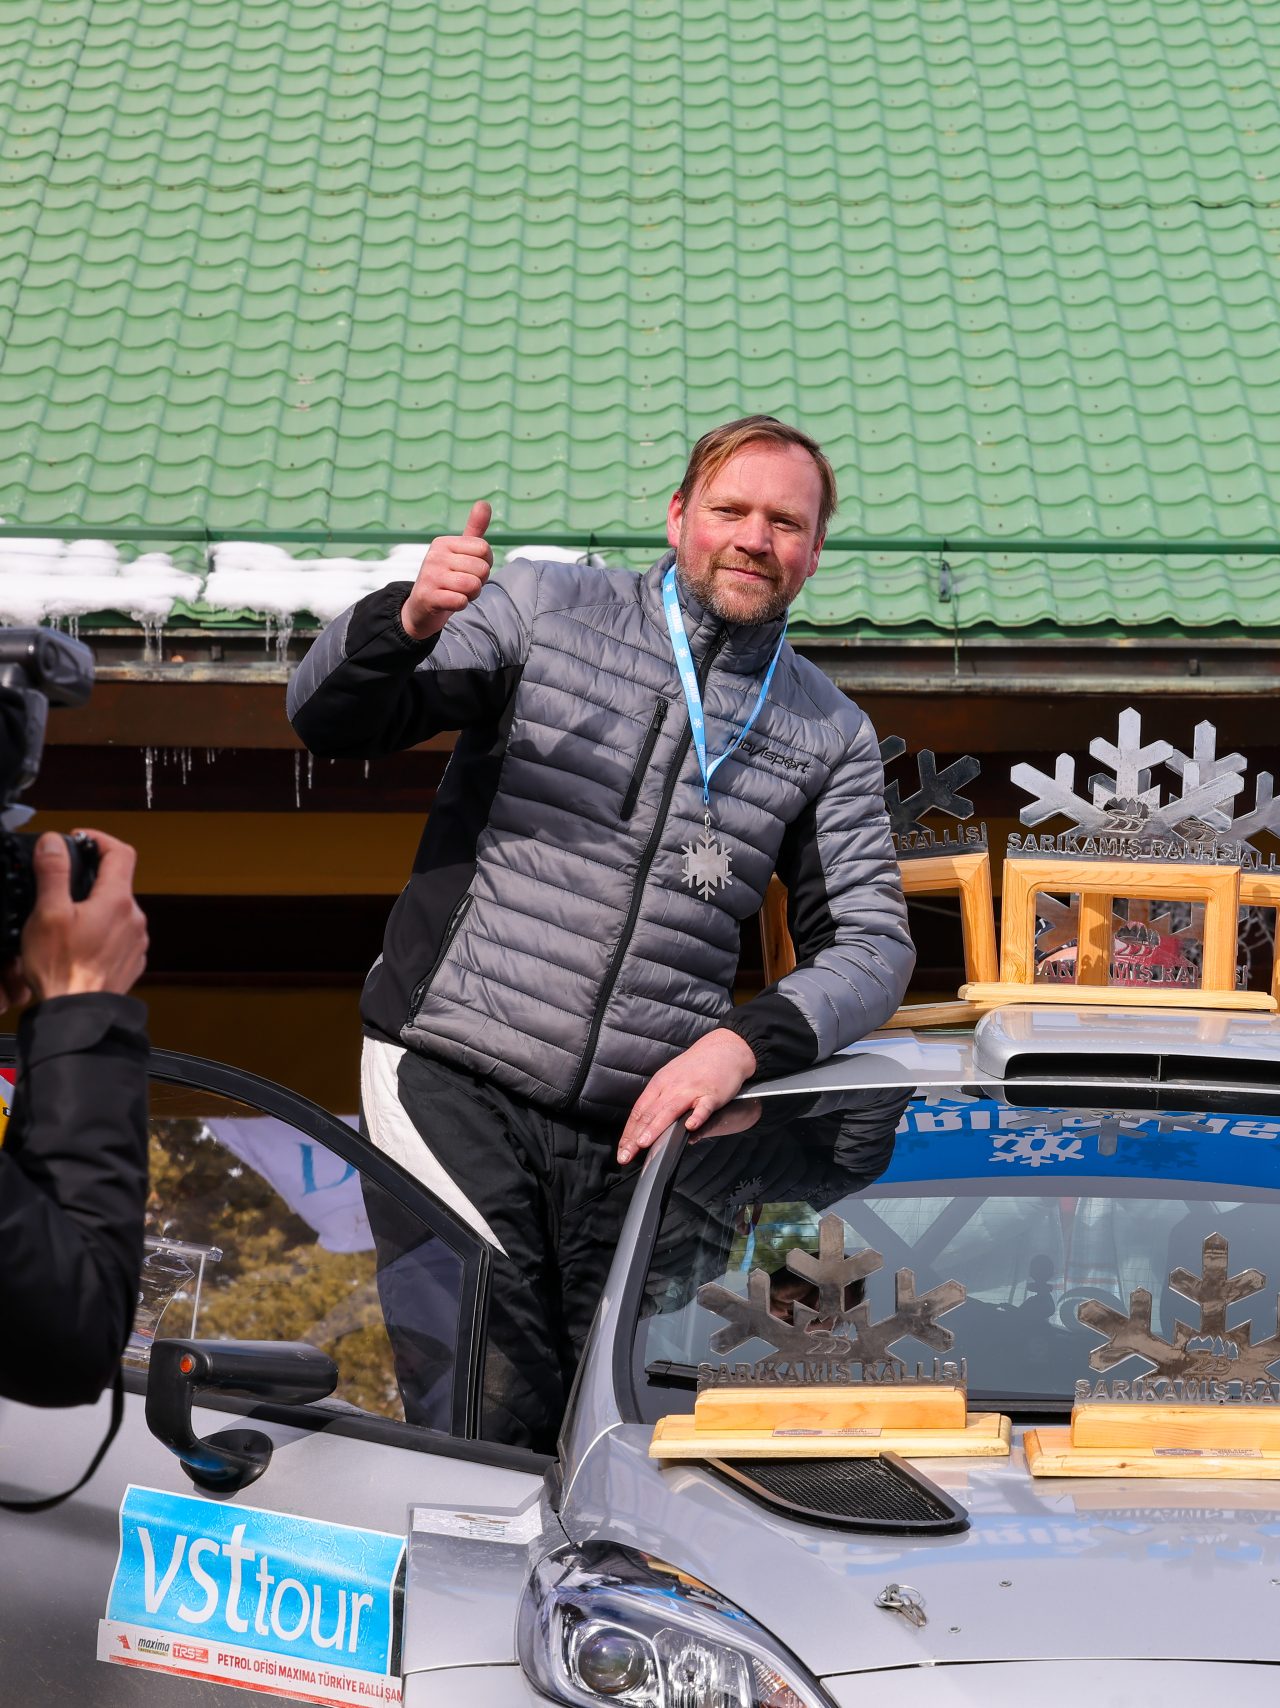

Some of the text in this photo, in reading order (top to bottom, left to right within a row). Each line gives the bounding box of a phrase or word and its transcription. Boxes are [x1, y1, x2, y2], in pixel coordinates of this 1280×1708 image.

[138, 1638, 170, 1652] maxima
[174, 1647, 196, 1659] TRS
[217, 1653, 252, 1671] PETROL
[253, 1658, 277, 1676] OFİSİ
[278, 1665, 317, 1683] MAXIMA
[318, 1672, 357, 1692] TÜRKİYE
[359, 1681, 384, 1698] RALLİ
